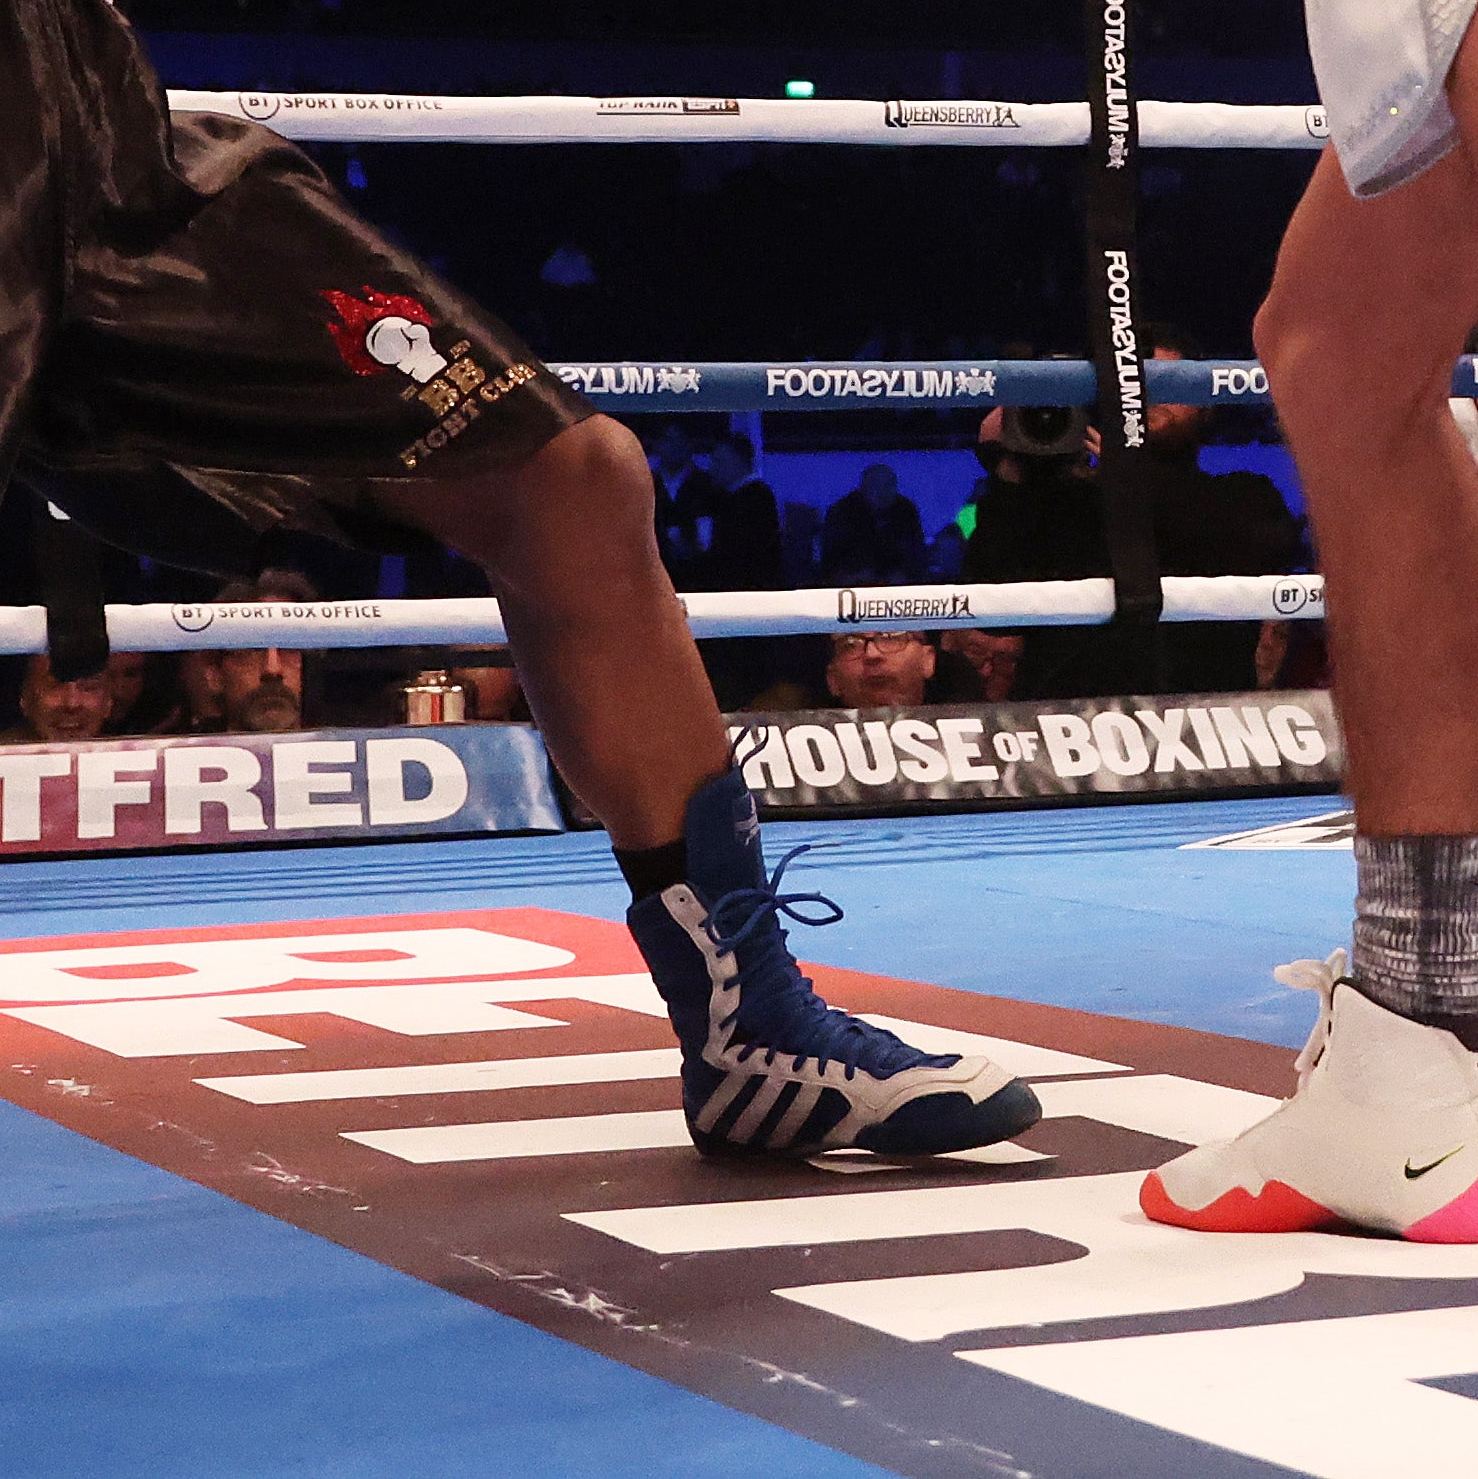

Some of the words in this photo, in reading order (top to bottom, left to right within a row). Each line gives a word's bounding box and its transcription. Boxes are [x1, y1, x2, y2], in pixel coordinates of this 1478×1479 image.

[284, 96, 338, 110] SPORT
[345, 97, 379, 111] BOX
[384, 98, 443, 112] OFFICE
[885, 100, 993, 129] QUEENSBERRY
[1104, 249, 1144, 411] FOOTASYLUM
[767, 368, 953, 399] FOOTASYLUM
[1211, 367, 1269, 397] FOO
[837, 588, 949, 624] QUEENSBERRY
[1279, 588, 1299, 603] BT
[1309, 588, 1322, 603] S
[182, 606, 202, 619] BT
[218, 606, 274, 620] SPORT
[281, 605, 317, 619] BOX
[320, 604, 382, 619] OFFICE
[729, 719, 999, 791] HOUSE
[995, 730, 1039, 764] OF
[1037, 705, 1327, 778] BOXING
